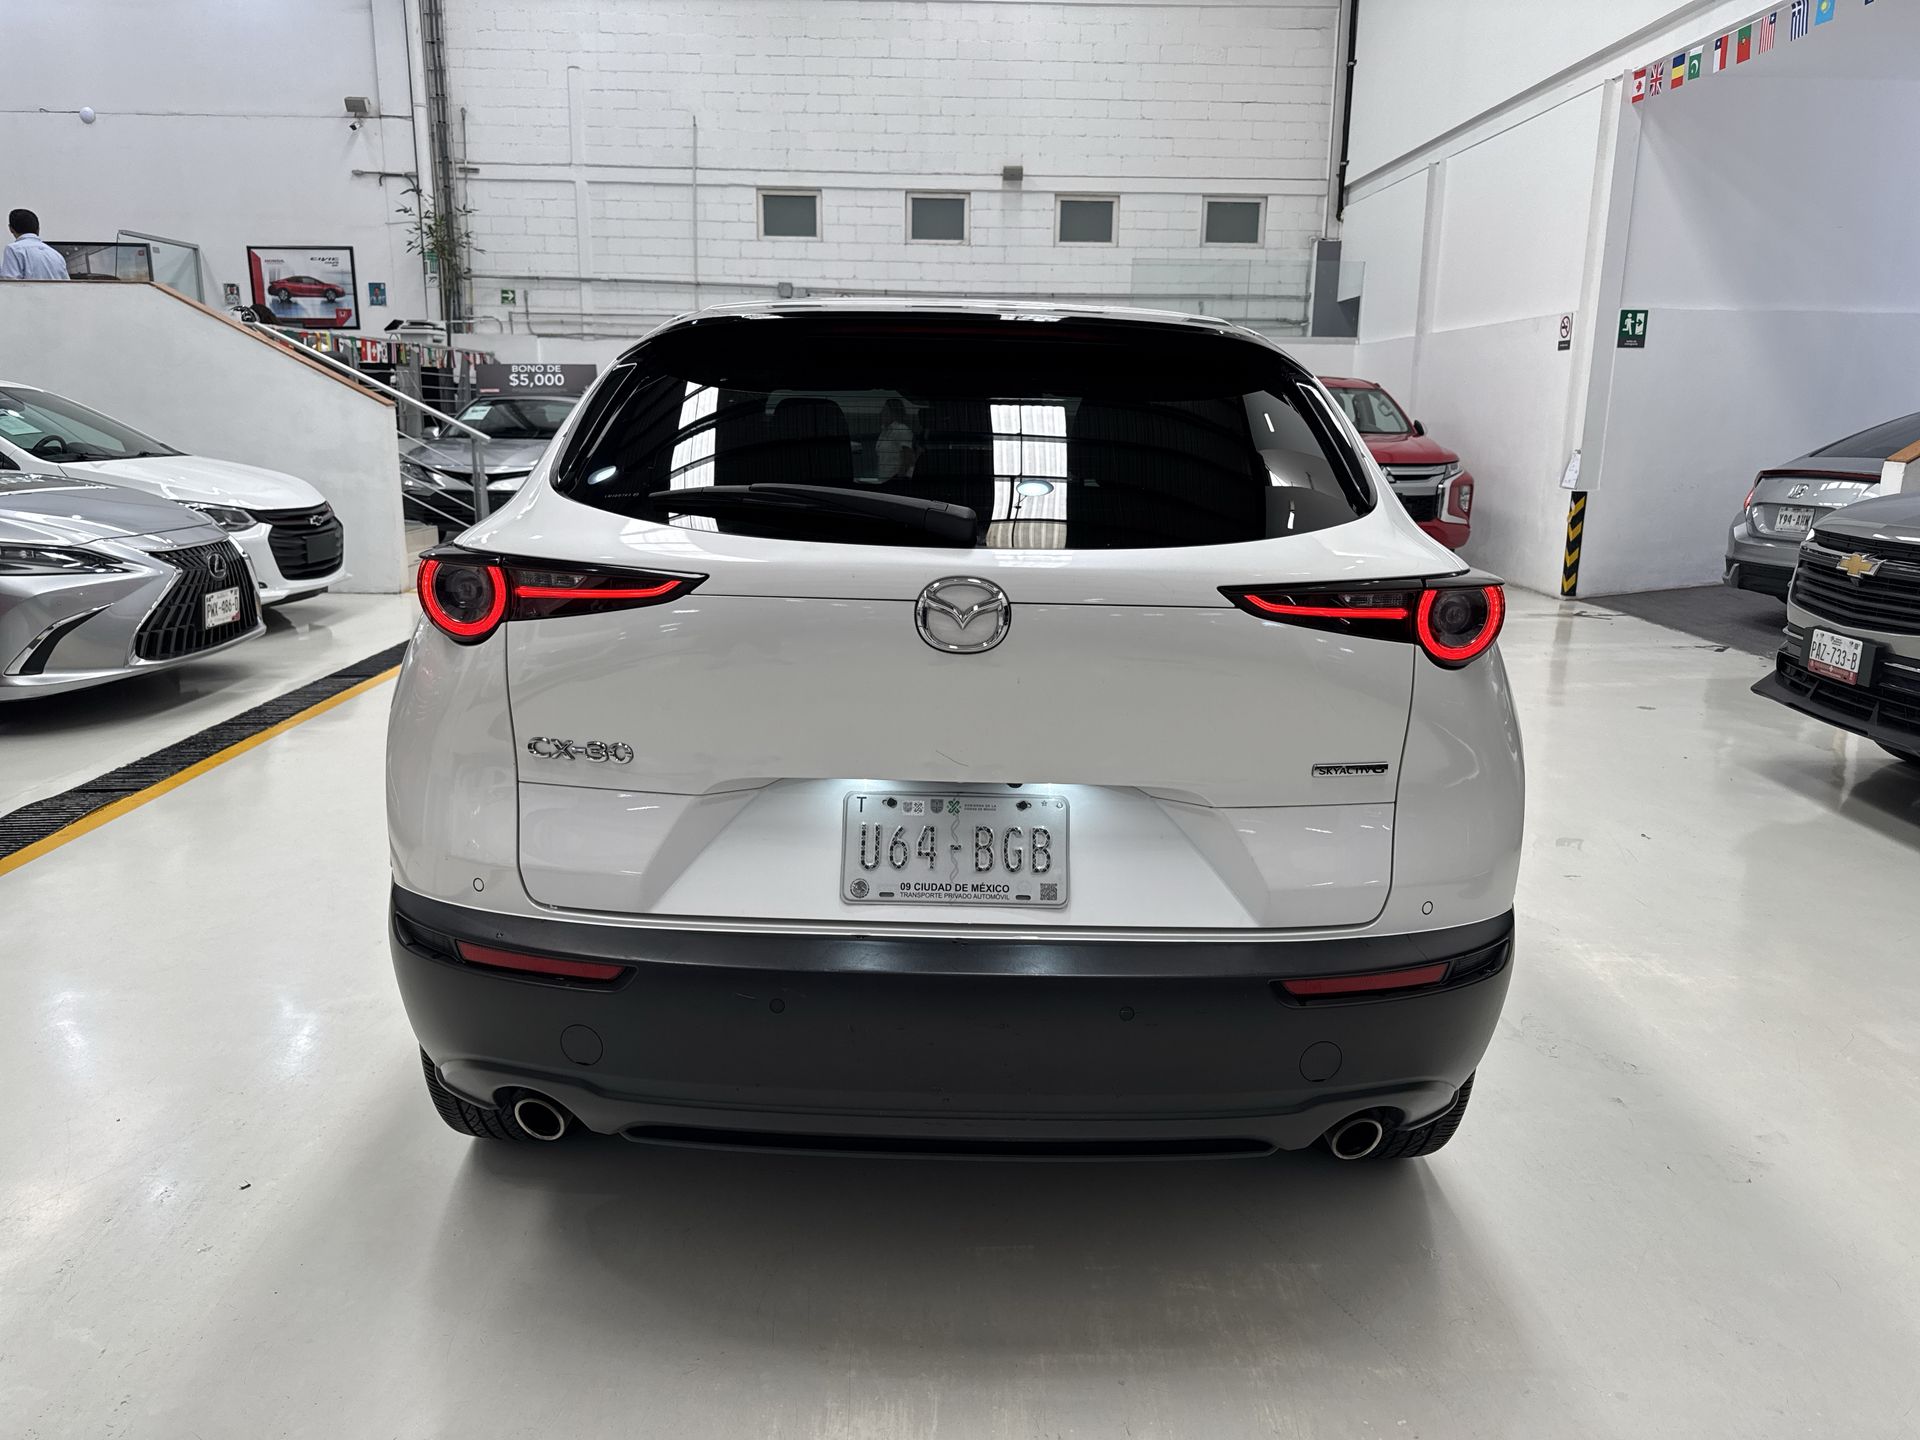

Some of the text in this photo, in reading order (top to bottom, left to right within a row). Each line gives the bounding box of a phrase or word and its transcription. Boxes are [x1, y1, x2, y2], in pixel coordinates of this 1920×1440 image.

[511, 365, 561, 373] BONO DE
[509, 373, 565, 388] $5,000
[1811, 640, 1858, 670] PAZ-733-B
[527, 736, 634, 764] CX-30
[856, 796, 867, 812] T
[860, 822, 1051, 873] U64-BGB
[900, 882, 1010, 893] 09 CIUDAD DE MÉXICO
[900, 891, 1010, 901] TRANSPORTE PRIVADO AUTOMÓVIL
